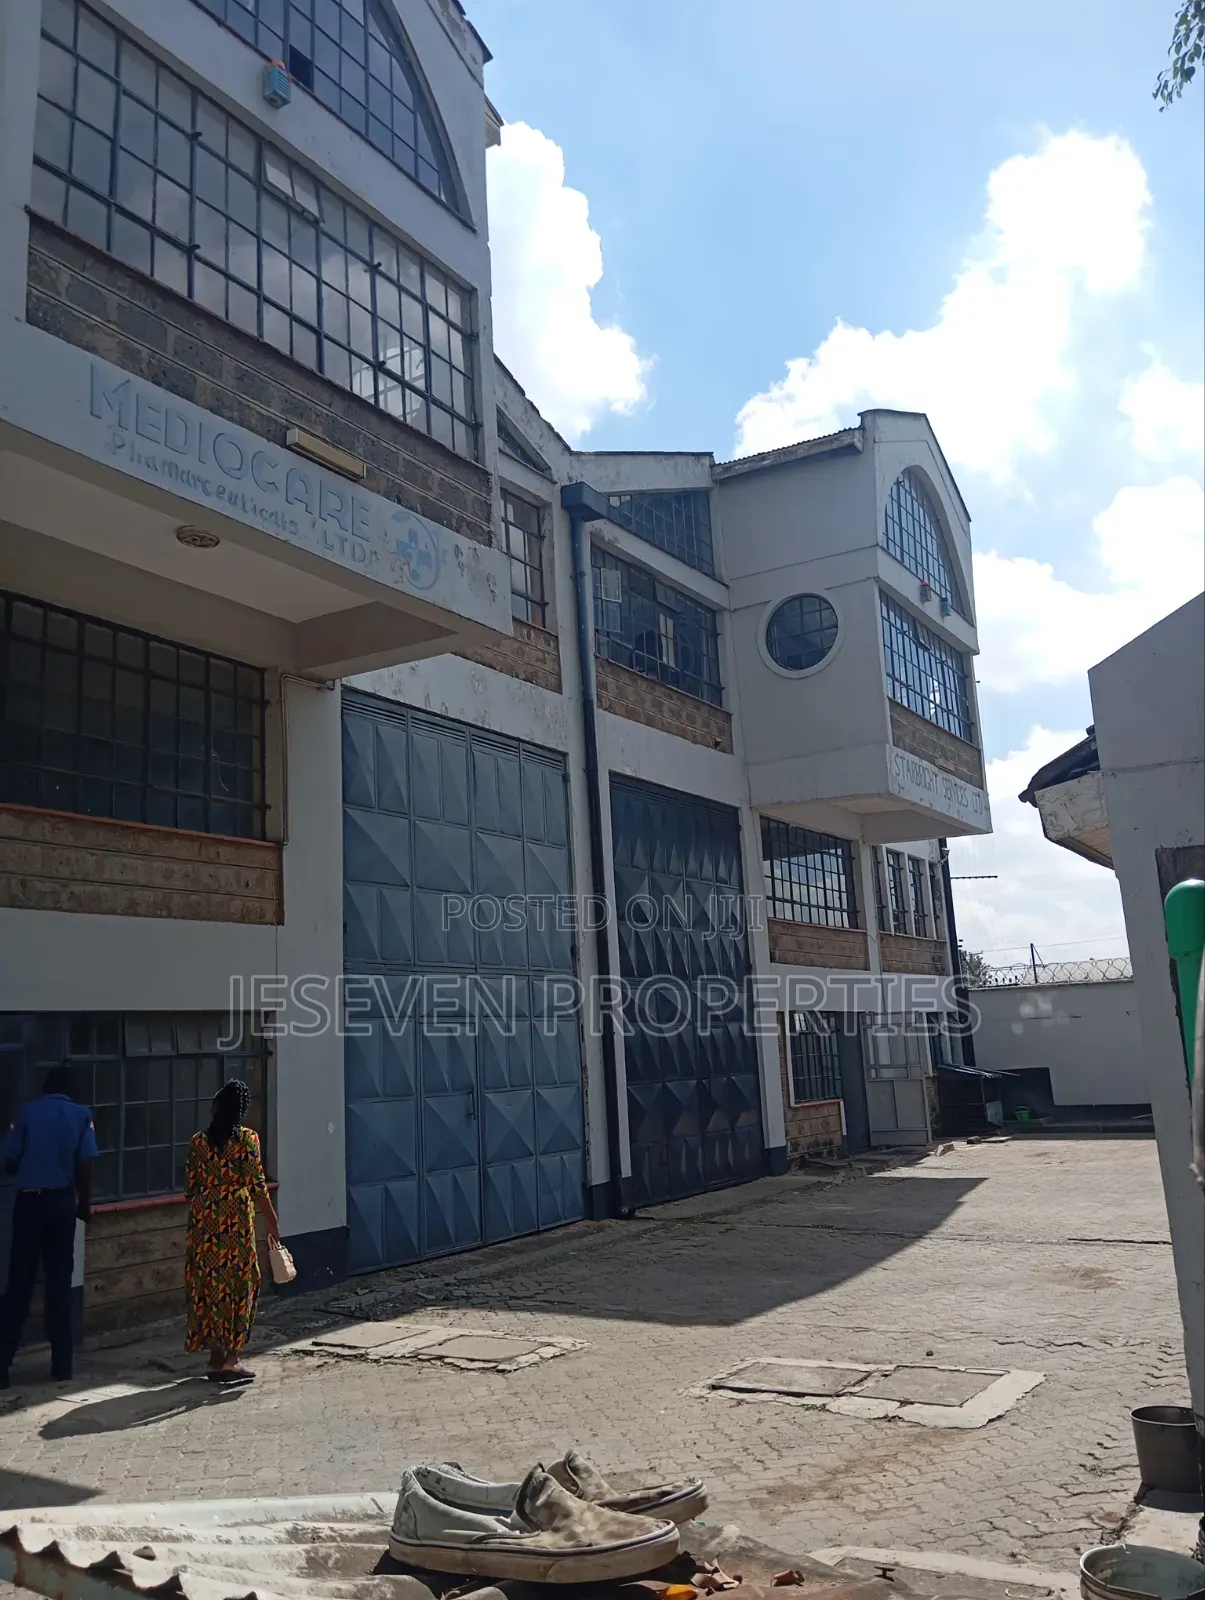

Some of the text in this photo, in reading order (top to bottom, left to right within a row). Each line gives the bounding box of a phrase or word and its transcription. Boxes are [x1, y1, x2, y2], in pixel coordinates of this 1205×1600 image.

[88, 361, 372, 542] MEDIOCARE
[322, 529, 366, 563] LTD
[972, 792, 984, 815] LTD
